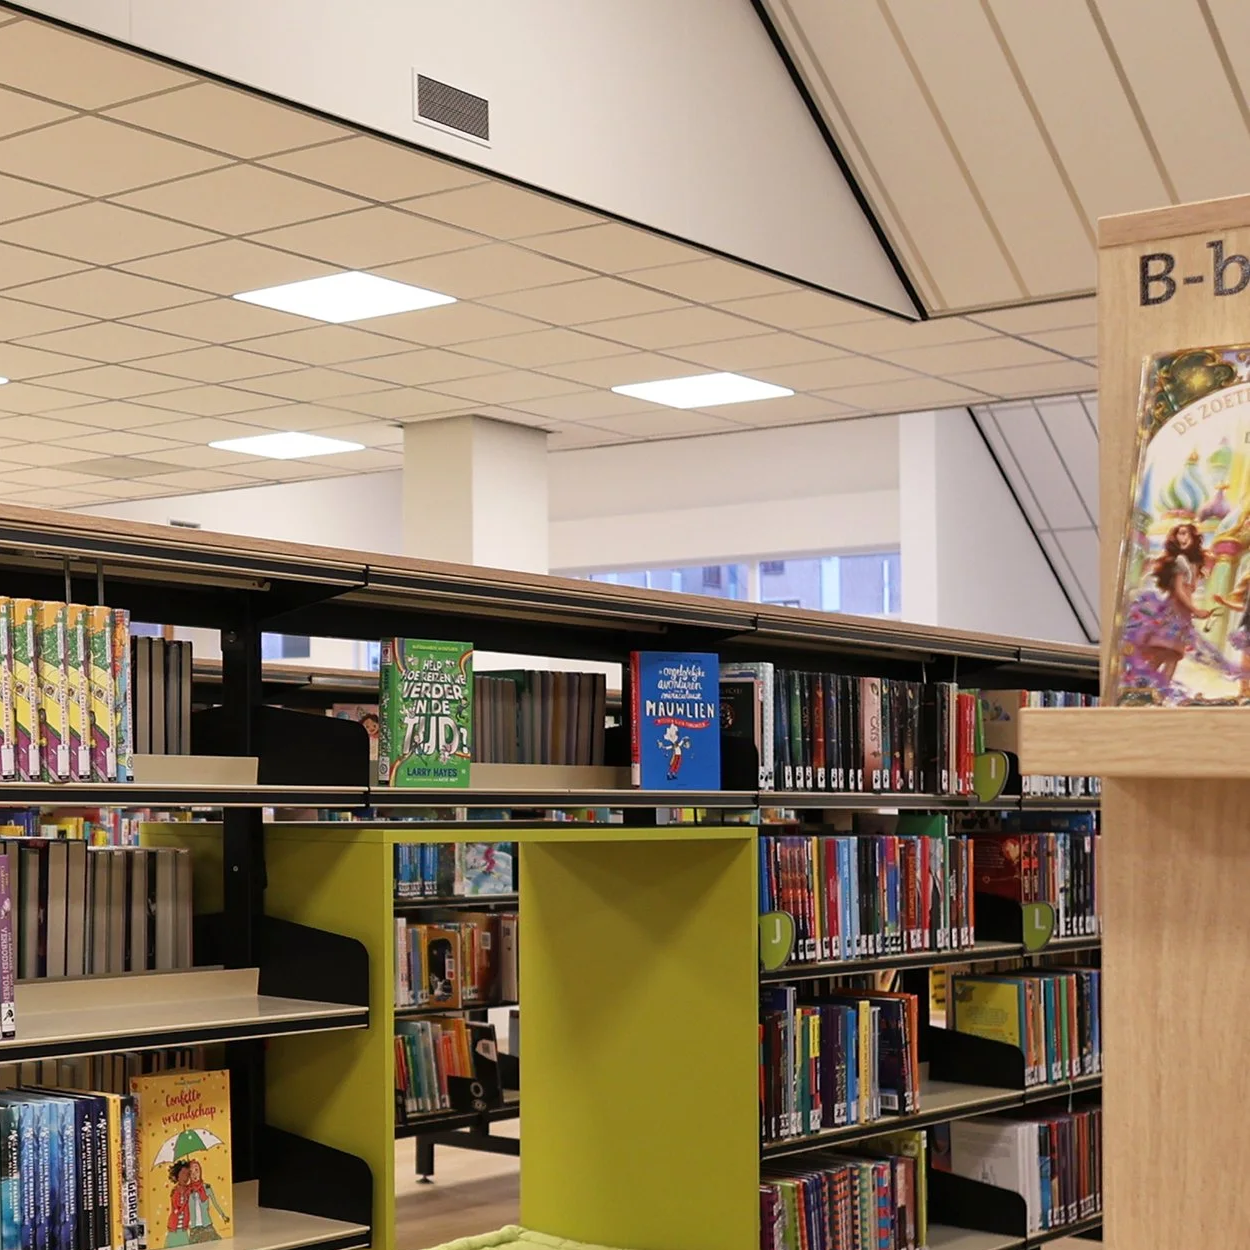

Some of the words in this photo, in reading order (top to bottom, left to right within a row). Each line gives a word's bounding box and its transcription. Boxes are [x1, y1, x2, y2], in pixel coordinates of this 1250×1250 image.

[1172, 415, 1197, 436] DE
[423, 660, 442, 671] HELP
[403, 682, 462, 699] VERDER
[432, 700, 450, 714] DE
[646, 700, 714, 718] MAUWLIEN
[407, 767, 431, 777] LARRY
[434, 768, 457, 777] HAYES
[1035, 908, 1046, 931] L
[772, 918, 782, 944] J
[1, 927, 9, 974] VERBODEN
[162, 1104, 216, 1125] vriendschap
[128, 1182, 138, 1225] GEORGE
